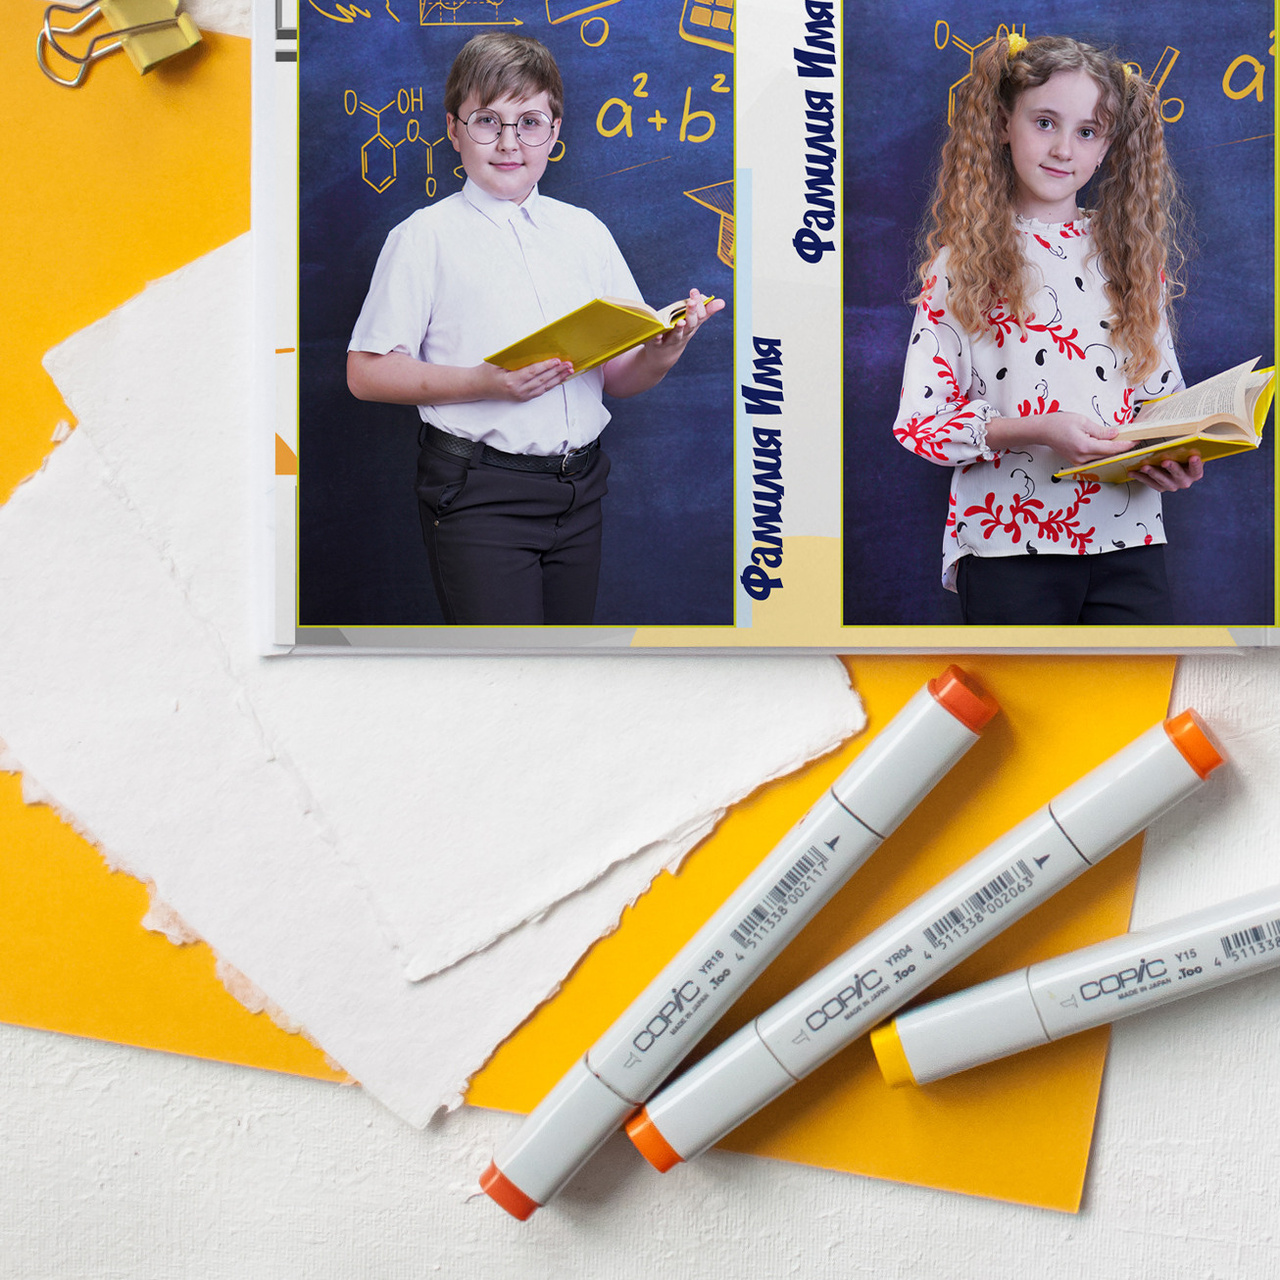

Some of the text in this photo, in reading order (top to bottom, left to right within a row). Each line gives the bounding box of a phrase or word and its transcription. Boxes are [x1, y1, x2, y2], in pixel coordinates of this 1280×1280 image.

[792, 0, 837, 264] Фамилия Имя
[740, 336, 785, 601] Фамилия Имя
[746, 905, 789, 949] 511338
[787, 858, 828, 905] 002117
[936, 911, 985, 951] 511338
[986, 874, 1034, 914] 002063
[698, 949, 725, 975] YR18
[884, 944, 914, 967] YR04
[1174, 948, 1198, 963] Y15
[843, 1004, 863, 1021] MADE
[870, 984, 891, 1002] JAPAN
[1117, 988, 1139, 1000] MADE
[1148, 977, 1172, 991] JAPAN
[669, 1017, 687, 1036] MADE
[692, 993, 710, 1014] JAPAN
